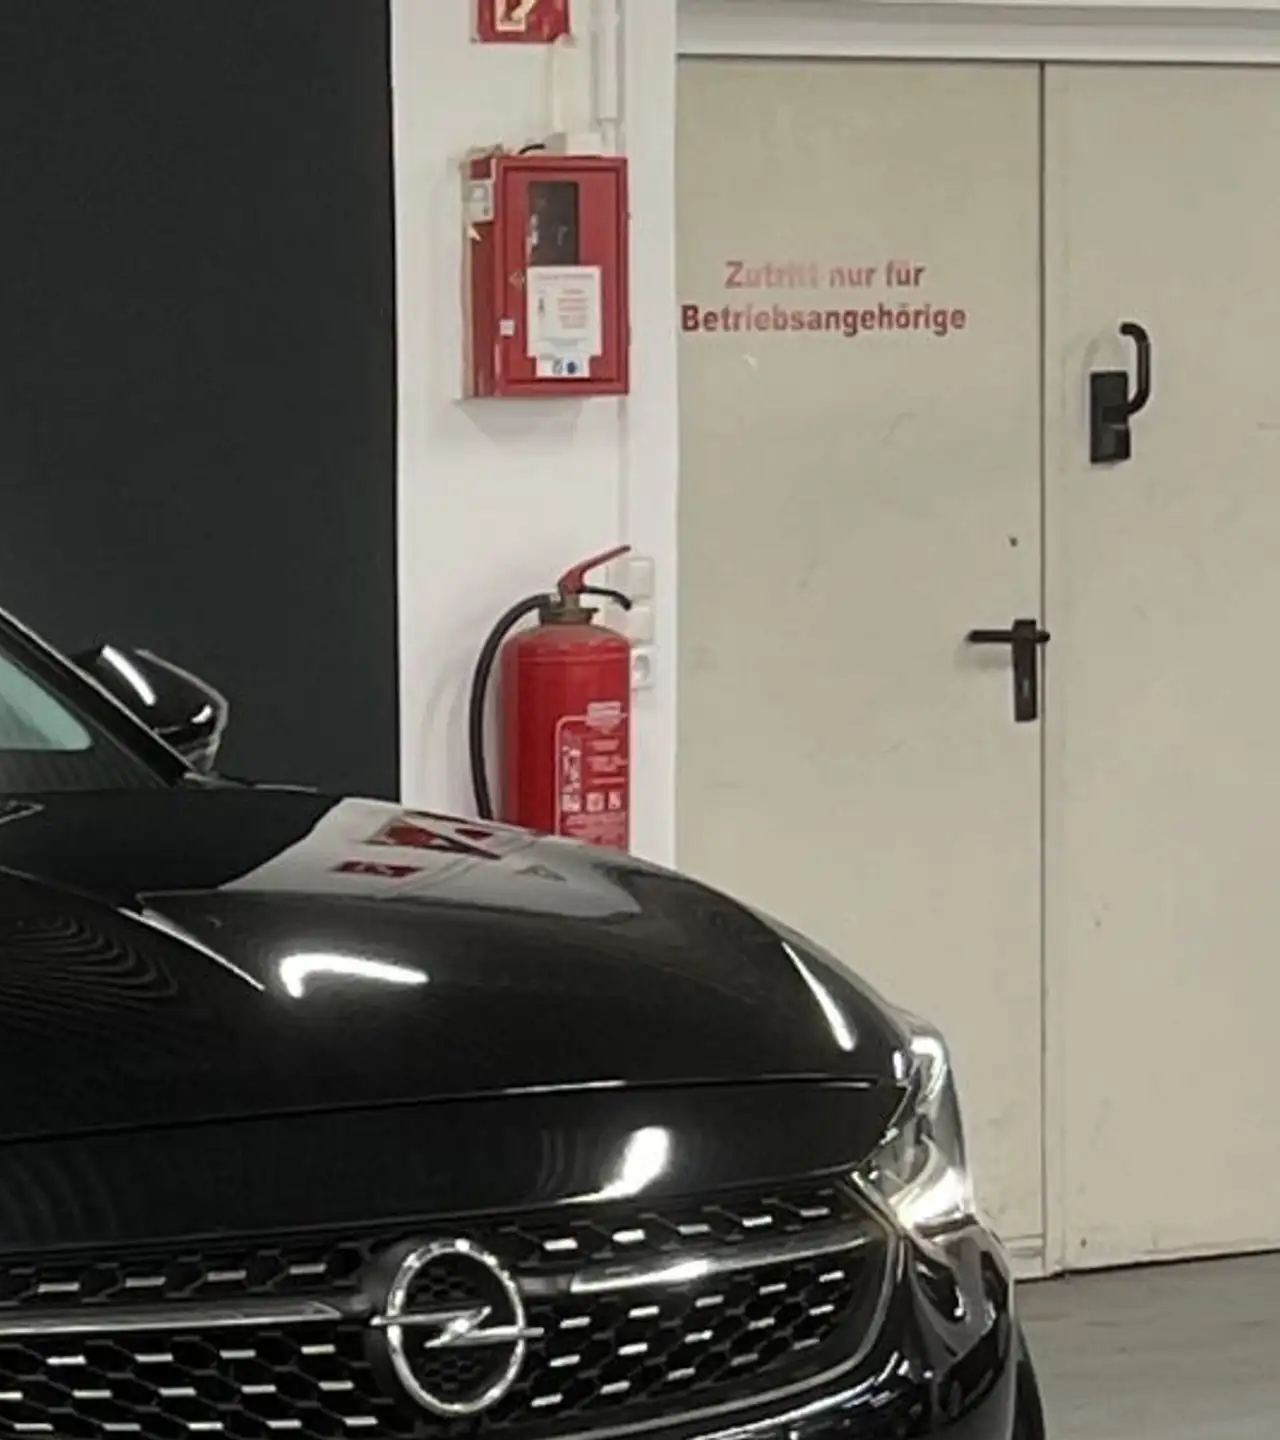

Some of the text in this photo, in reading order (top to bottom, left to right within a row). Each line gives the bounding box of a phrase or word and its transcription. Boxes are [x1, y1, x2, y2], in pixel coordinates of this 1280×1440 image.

[724, 259, 927, 289] Zutritt nur für
[680, 302, 968, 338] Betriebsangehörige
